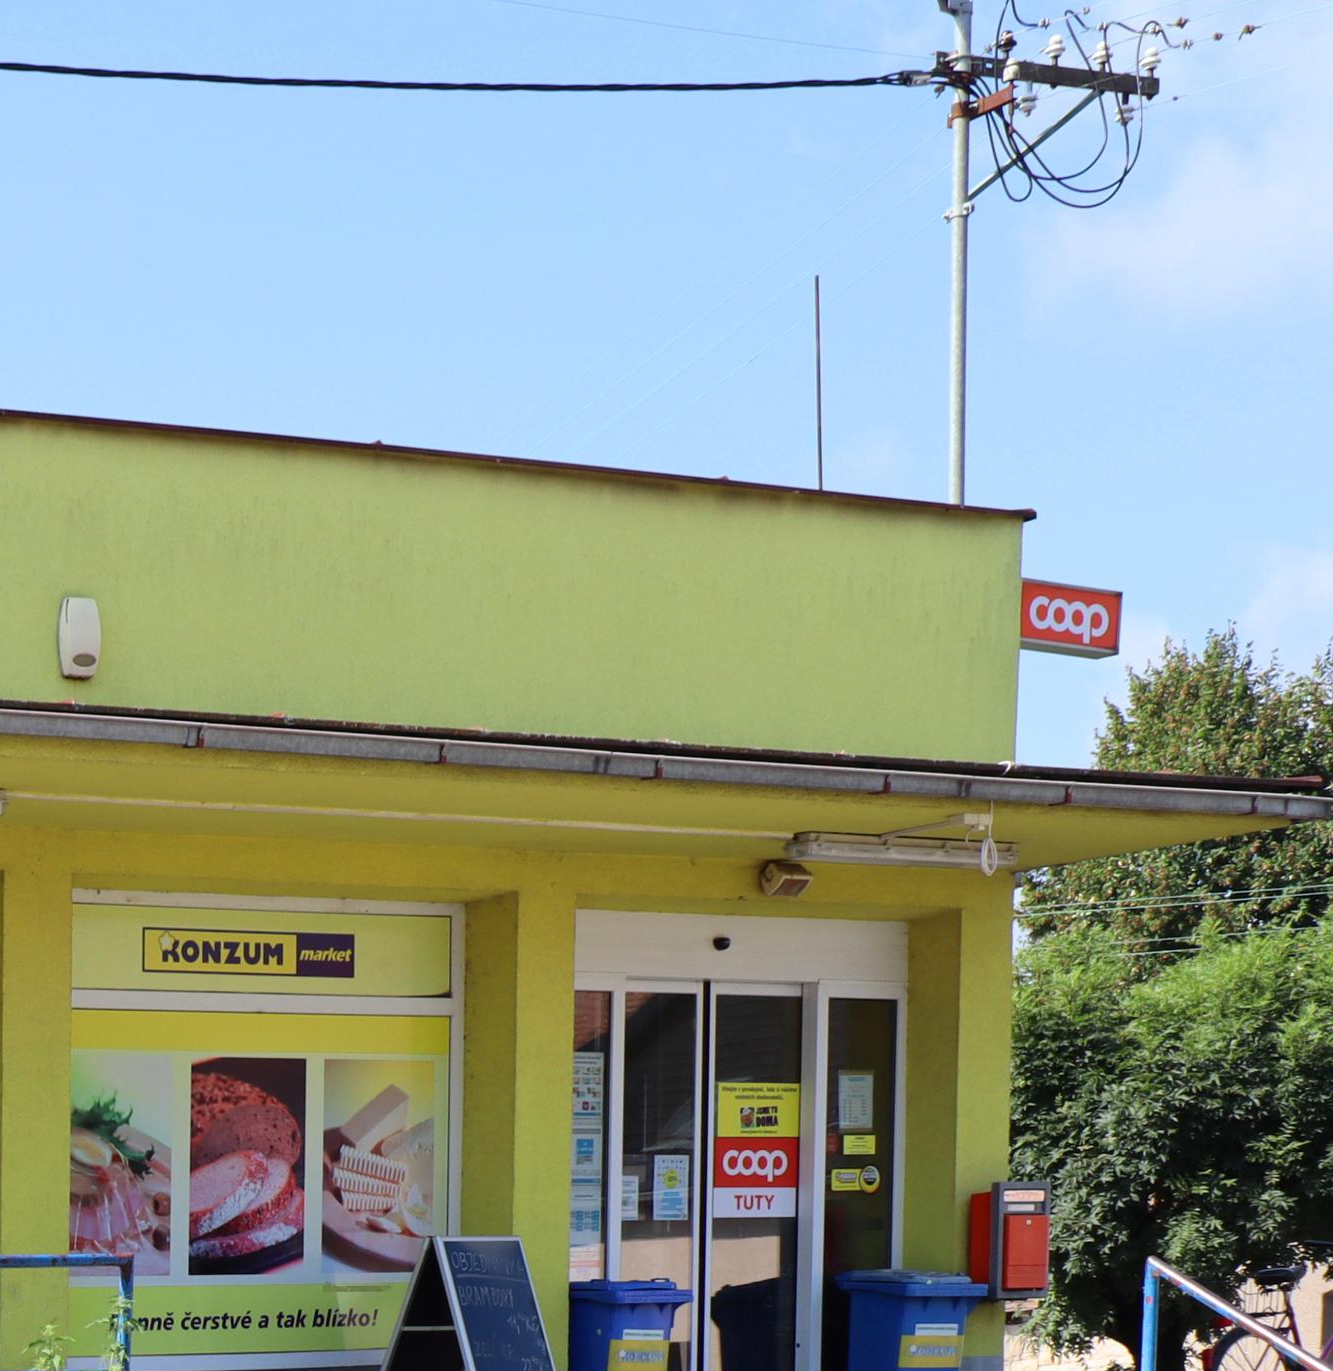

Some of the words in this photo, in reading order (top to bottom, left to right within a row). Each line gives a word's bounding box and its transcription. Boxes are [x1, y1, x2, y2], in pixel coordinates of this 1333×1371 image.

[1029, 596, 1110, 644] coop
[162, 939, 284, 966] KONZUM
[299, 947, 352, 962] market
[722, 1149, 788, 1183] coop
[734, 1194, 775, 1211] TUTY
[181, 1311, 252, 1331] čerstvé
[258, 1314, 270, 1329] a
[276, 1309, 306, 1328] tak
[312, 1308, 379, 1328] blízko!
